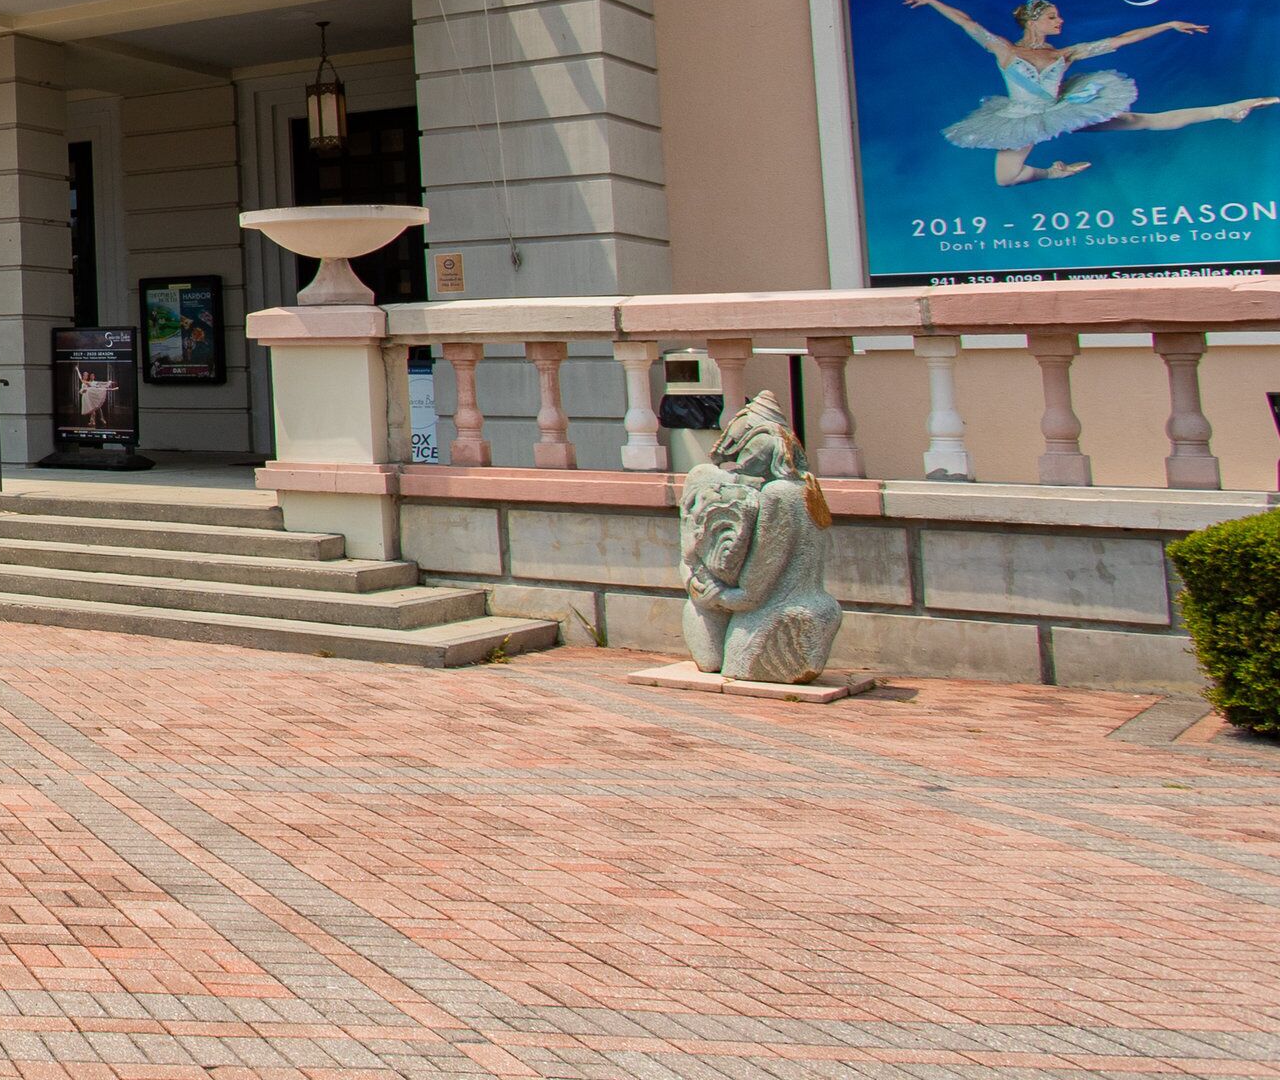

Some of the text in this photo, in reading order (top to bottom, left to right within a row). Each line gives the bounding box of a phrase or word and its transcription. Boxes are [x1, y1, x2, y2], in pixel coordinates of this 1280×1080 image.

[911, 216, 987, 237] 2019
[1032, 210, 1115, 231] 2020
[1131, 201, 1278, 226] SEASON
[940, 229, 1252, 252] Don't Miss Out! Subscribe Today
[411, 433, 431, 446] OX
